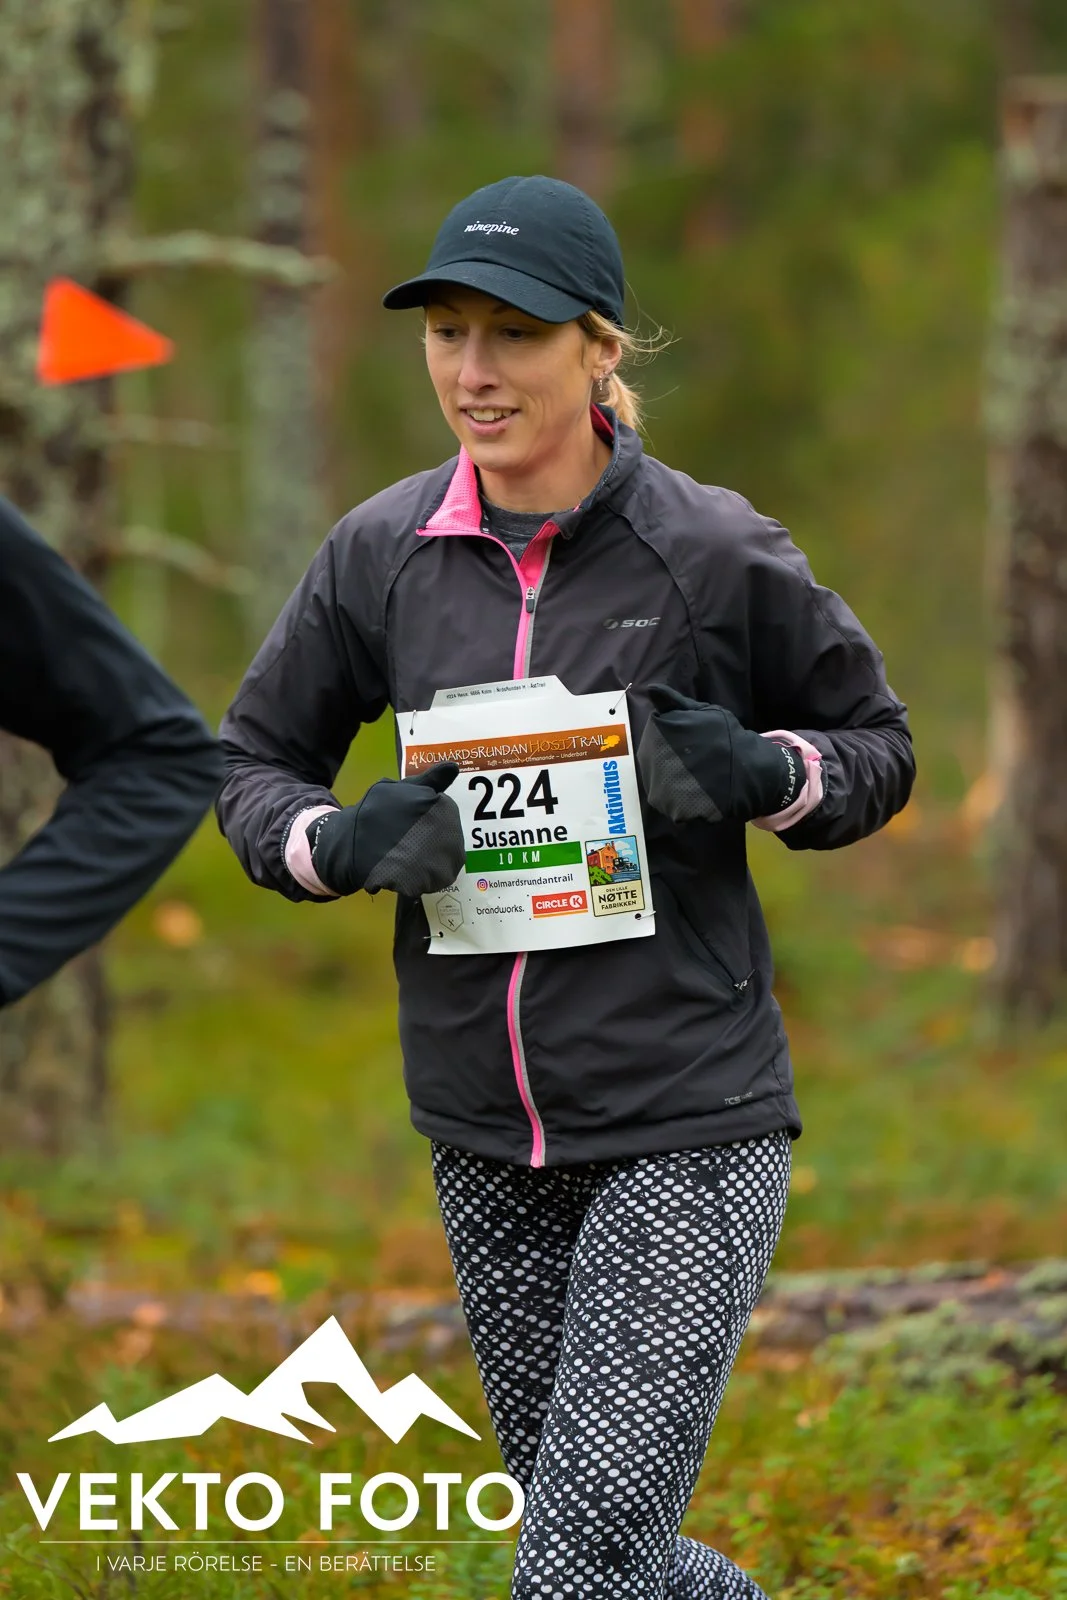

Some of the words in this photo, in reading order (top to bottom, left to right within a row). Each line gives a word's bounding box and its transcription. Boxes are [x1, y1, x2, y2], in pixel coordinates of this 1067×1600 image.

[464, 220, 520, 235] ninepine
[560, 749, 588, 759] Underbart
[781, 747, 796, 795] CRAFT
[468, 769, 558, 821] 224
[603, 760, 627, 834] Aktivitus
[471, 825, 568, 849] Susanne
[499, 852, 513, 866] 10
[522, 850, 541, 864] KM
[489, 873, 574, 889] kolmardsrundantrail
[535, 899, 568, 910] CIRCLE
[570, 895, 583, 908] K
[598, 889, 638, 904] NØTTE
[601, 900, 637, 911] FABRIKKEN
